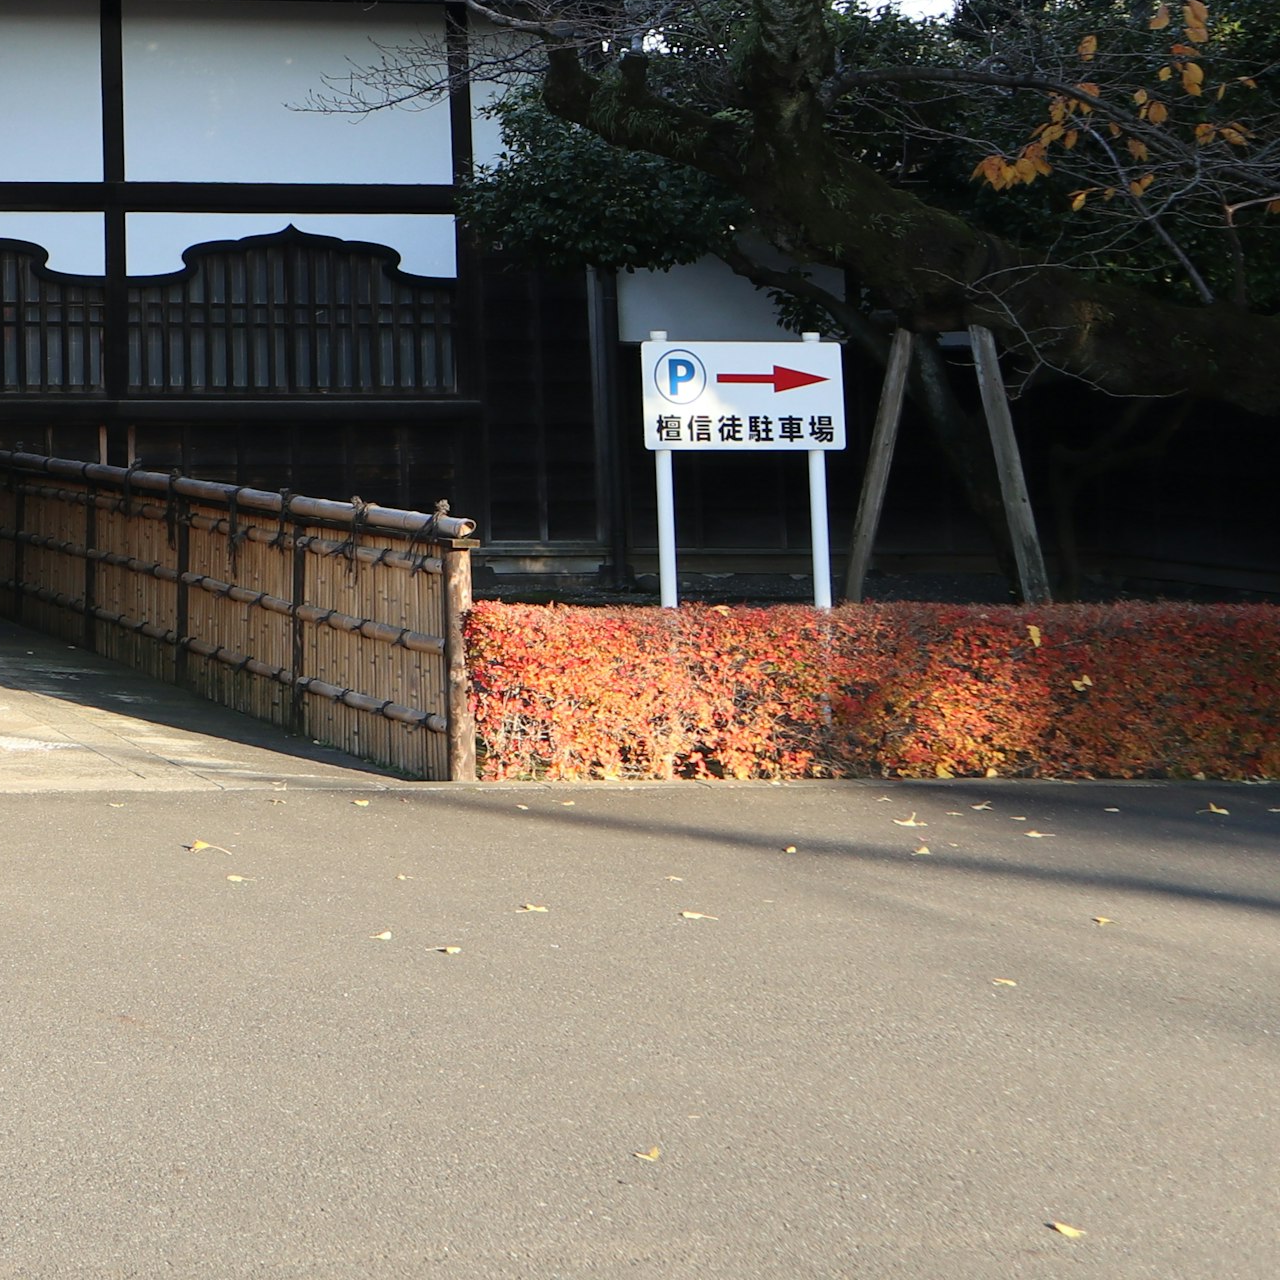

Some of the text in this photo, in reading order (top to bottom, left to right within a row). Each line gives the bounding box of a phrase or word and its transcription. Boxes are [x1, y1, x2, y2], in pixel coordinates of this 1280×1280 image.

[668, 358, 695, 395] P
[656, 414, 834, 442] 檀信徒駐車場
